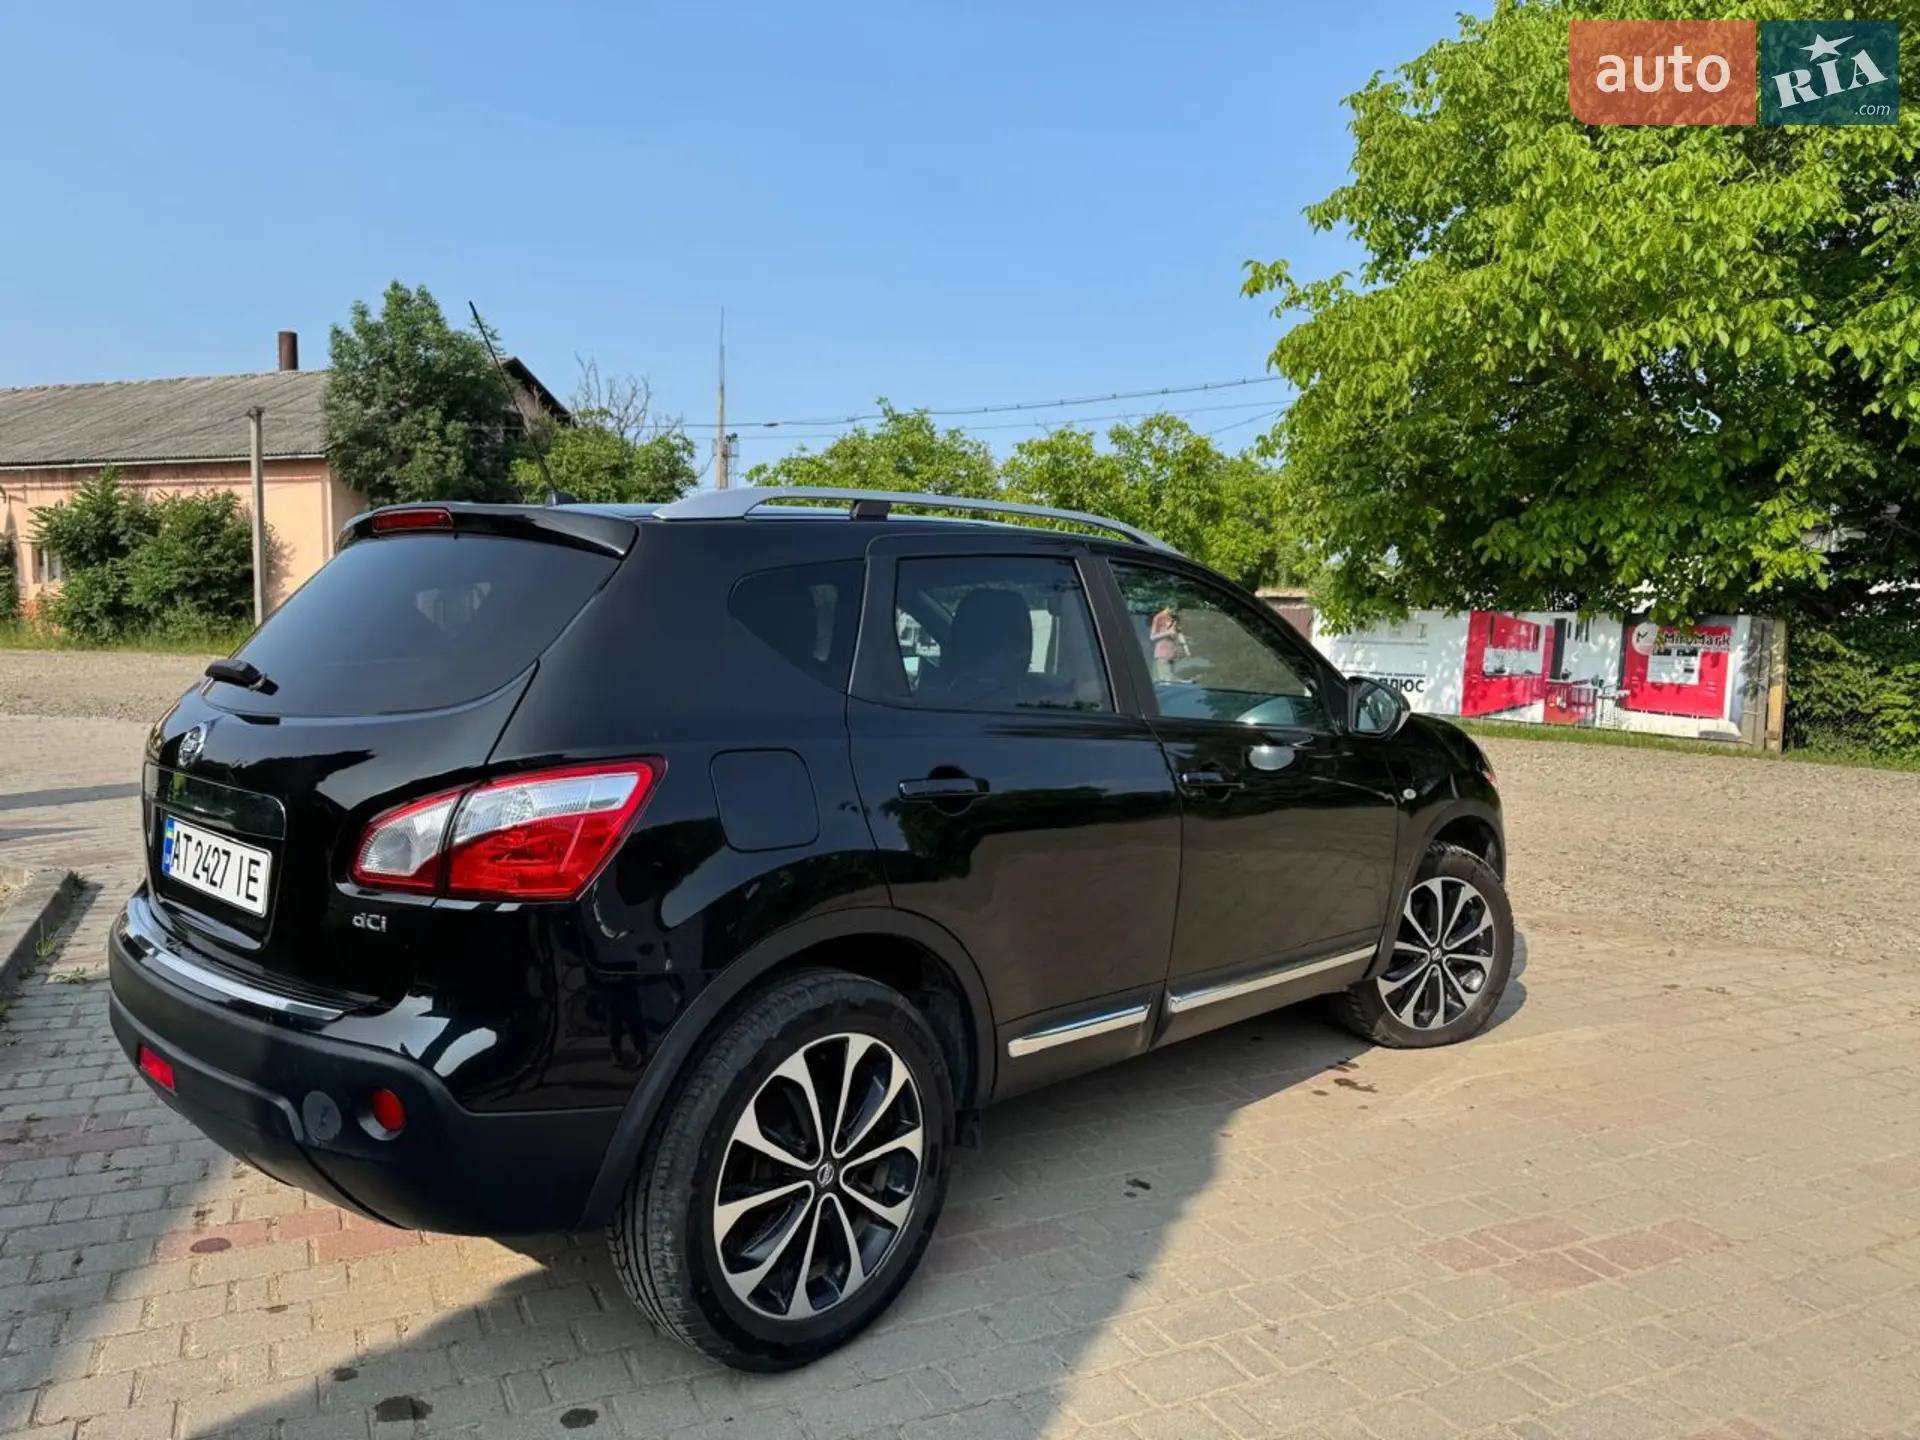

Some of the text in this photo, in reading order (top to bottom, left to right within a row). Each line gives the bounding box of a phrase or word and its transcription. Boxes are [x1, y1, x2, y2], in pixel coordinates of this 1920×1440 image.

[172, 830, 261, 903] AT 2427 IE
[352, 912, 387, 933] dCi
